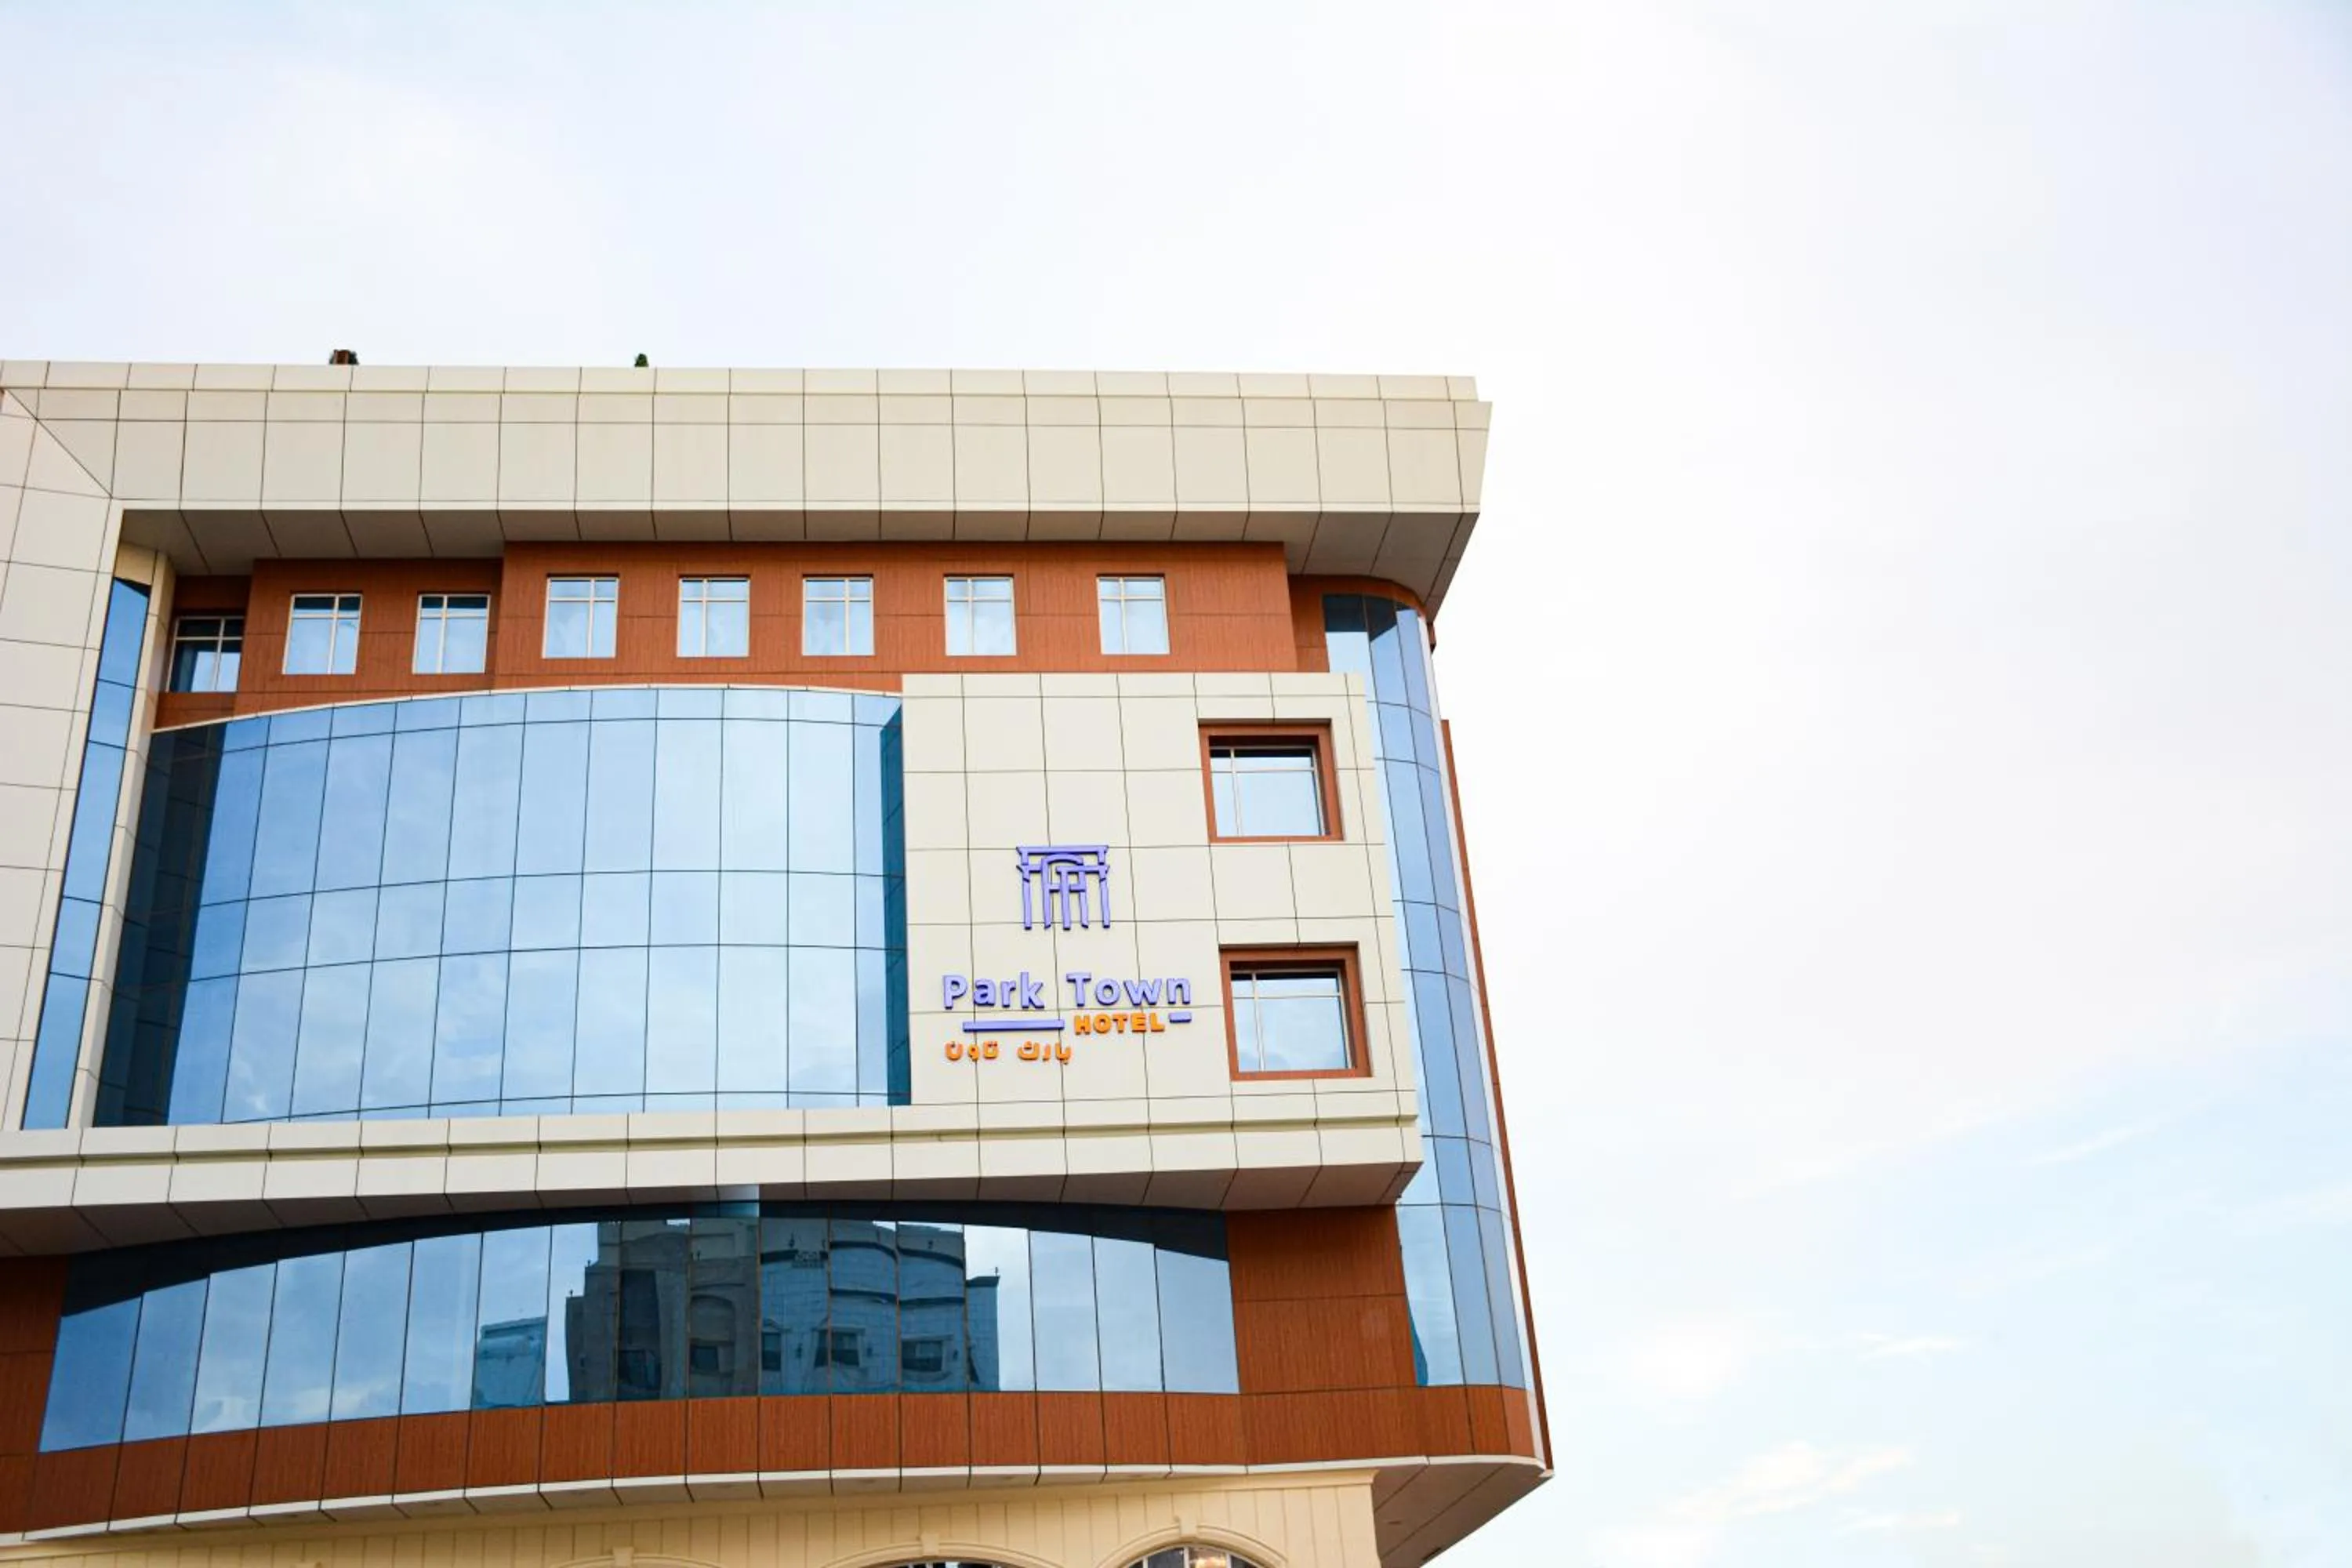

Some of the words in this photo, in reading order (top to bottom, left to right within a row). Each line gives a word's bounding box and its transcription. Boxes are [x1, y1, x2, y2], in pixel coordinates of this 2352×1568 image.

[942, 971, 1044, 1009] Park
[1066, 972, 1192, 1007] Town
[1074, 1012, 1165, 1035] HOTEL
[945, 1040, 999, 1062] تون
